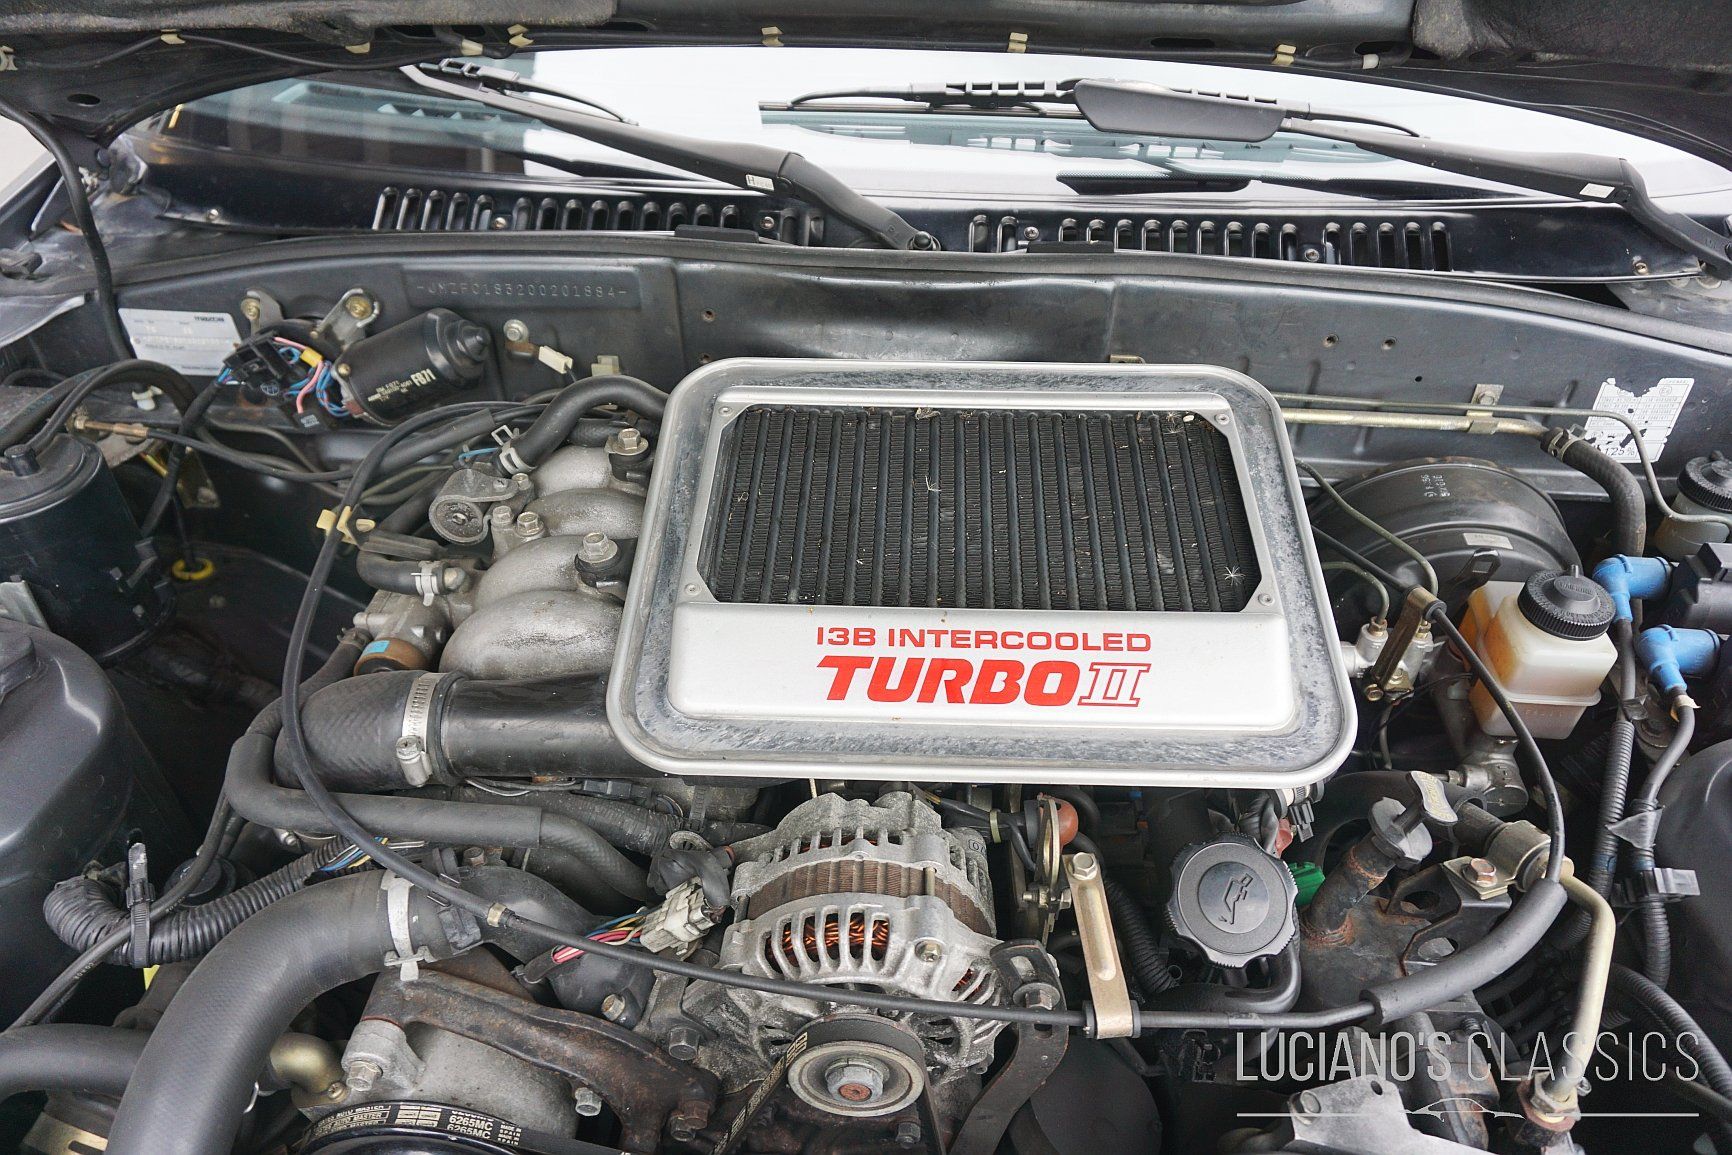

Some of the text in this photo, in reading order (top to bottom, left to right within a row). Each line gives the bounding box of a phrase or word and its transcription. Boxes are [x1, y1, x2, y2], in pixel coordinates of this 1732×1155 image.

[816, 627, 1152, 651] 13B INTERCOOLED
[816, 655, 1152, 707] TURBO II
[449, 1115, 494, 1131] 6265MC
[499, 1129, 521, 1137] SPAIN
